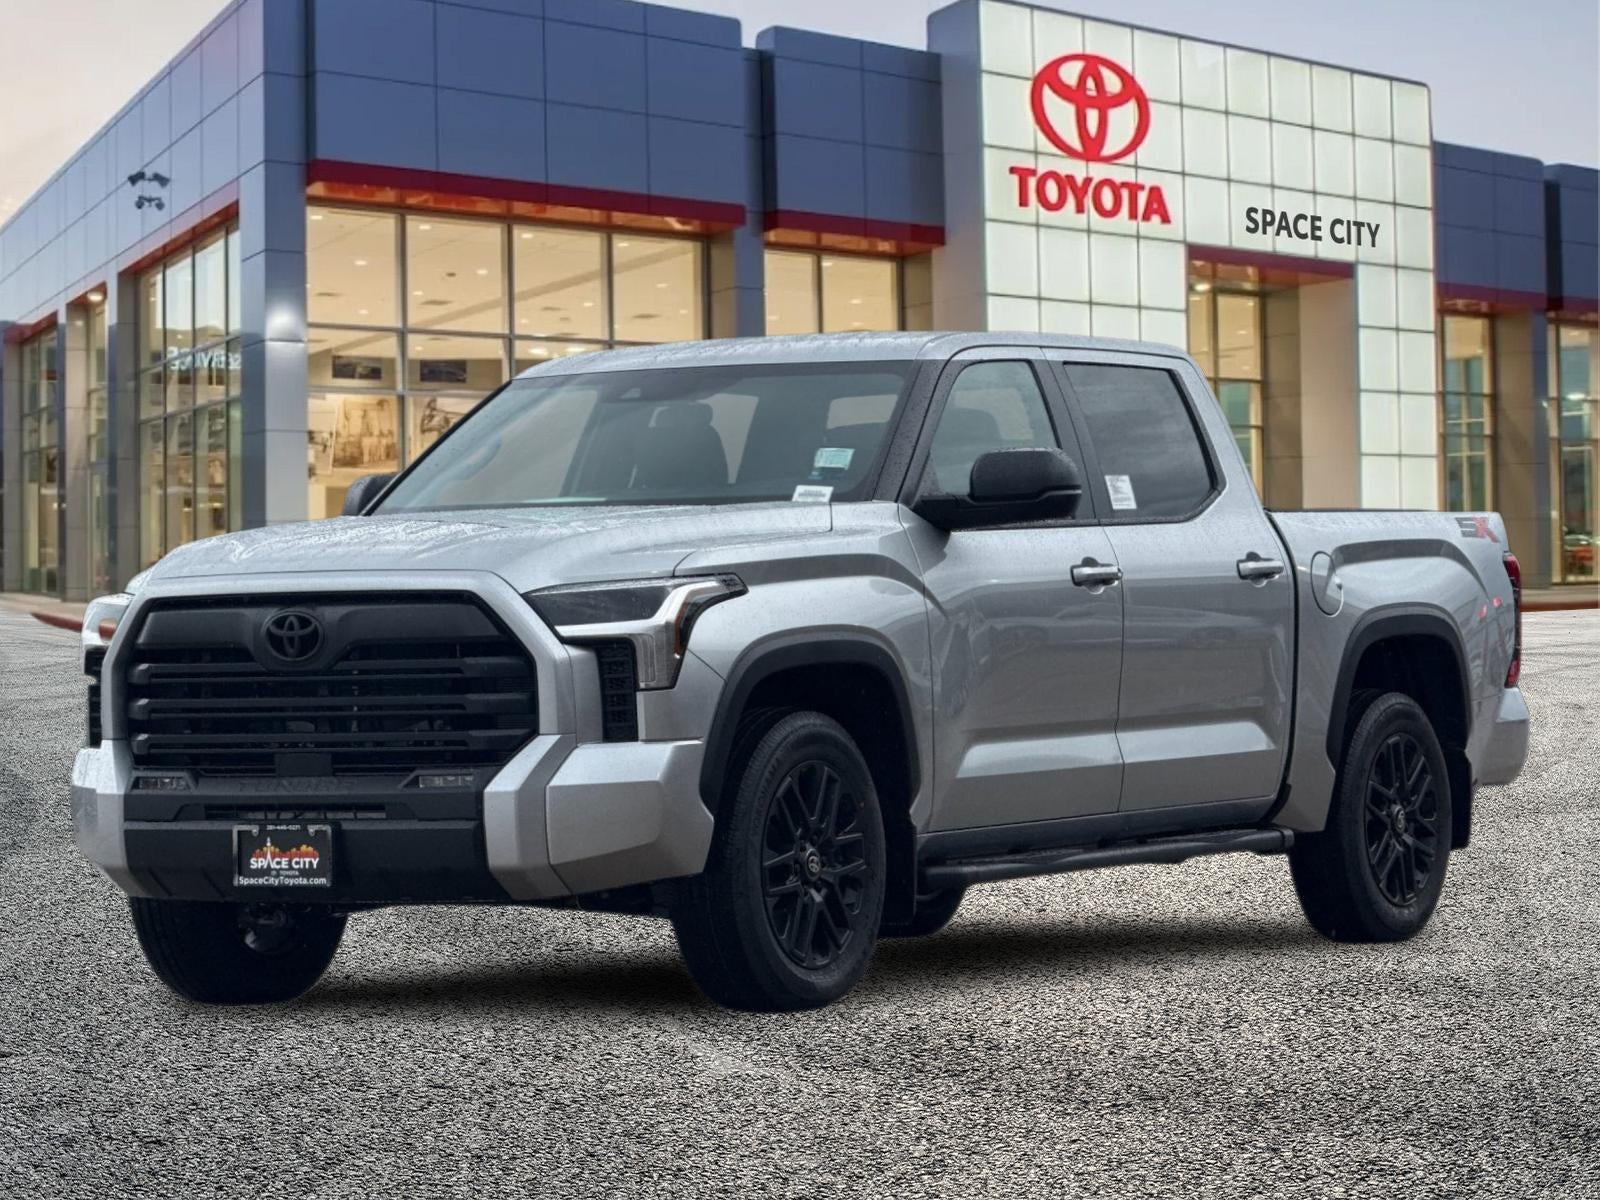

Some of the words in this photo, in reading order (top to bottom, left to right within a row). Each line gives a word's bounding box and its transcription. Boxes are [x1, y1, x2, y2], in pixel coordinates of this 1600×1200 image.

[1009, 166, 1171, 224] TOYOTA
[1245, 206, 1322, 242] SPACE
[1329, 218, 1380, 248] CITY
[250, 857, 289, 869] SPACE
[291, 857, 319, 869] CITY
[239, 876, 327, 886] SpaceCityToyota.com
